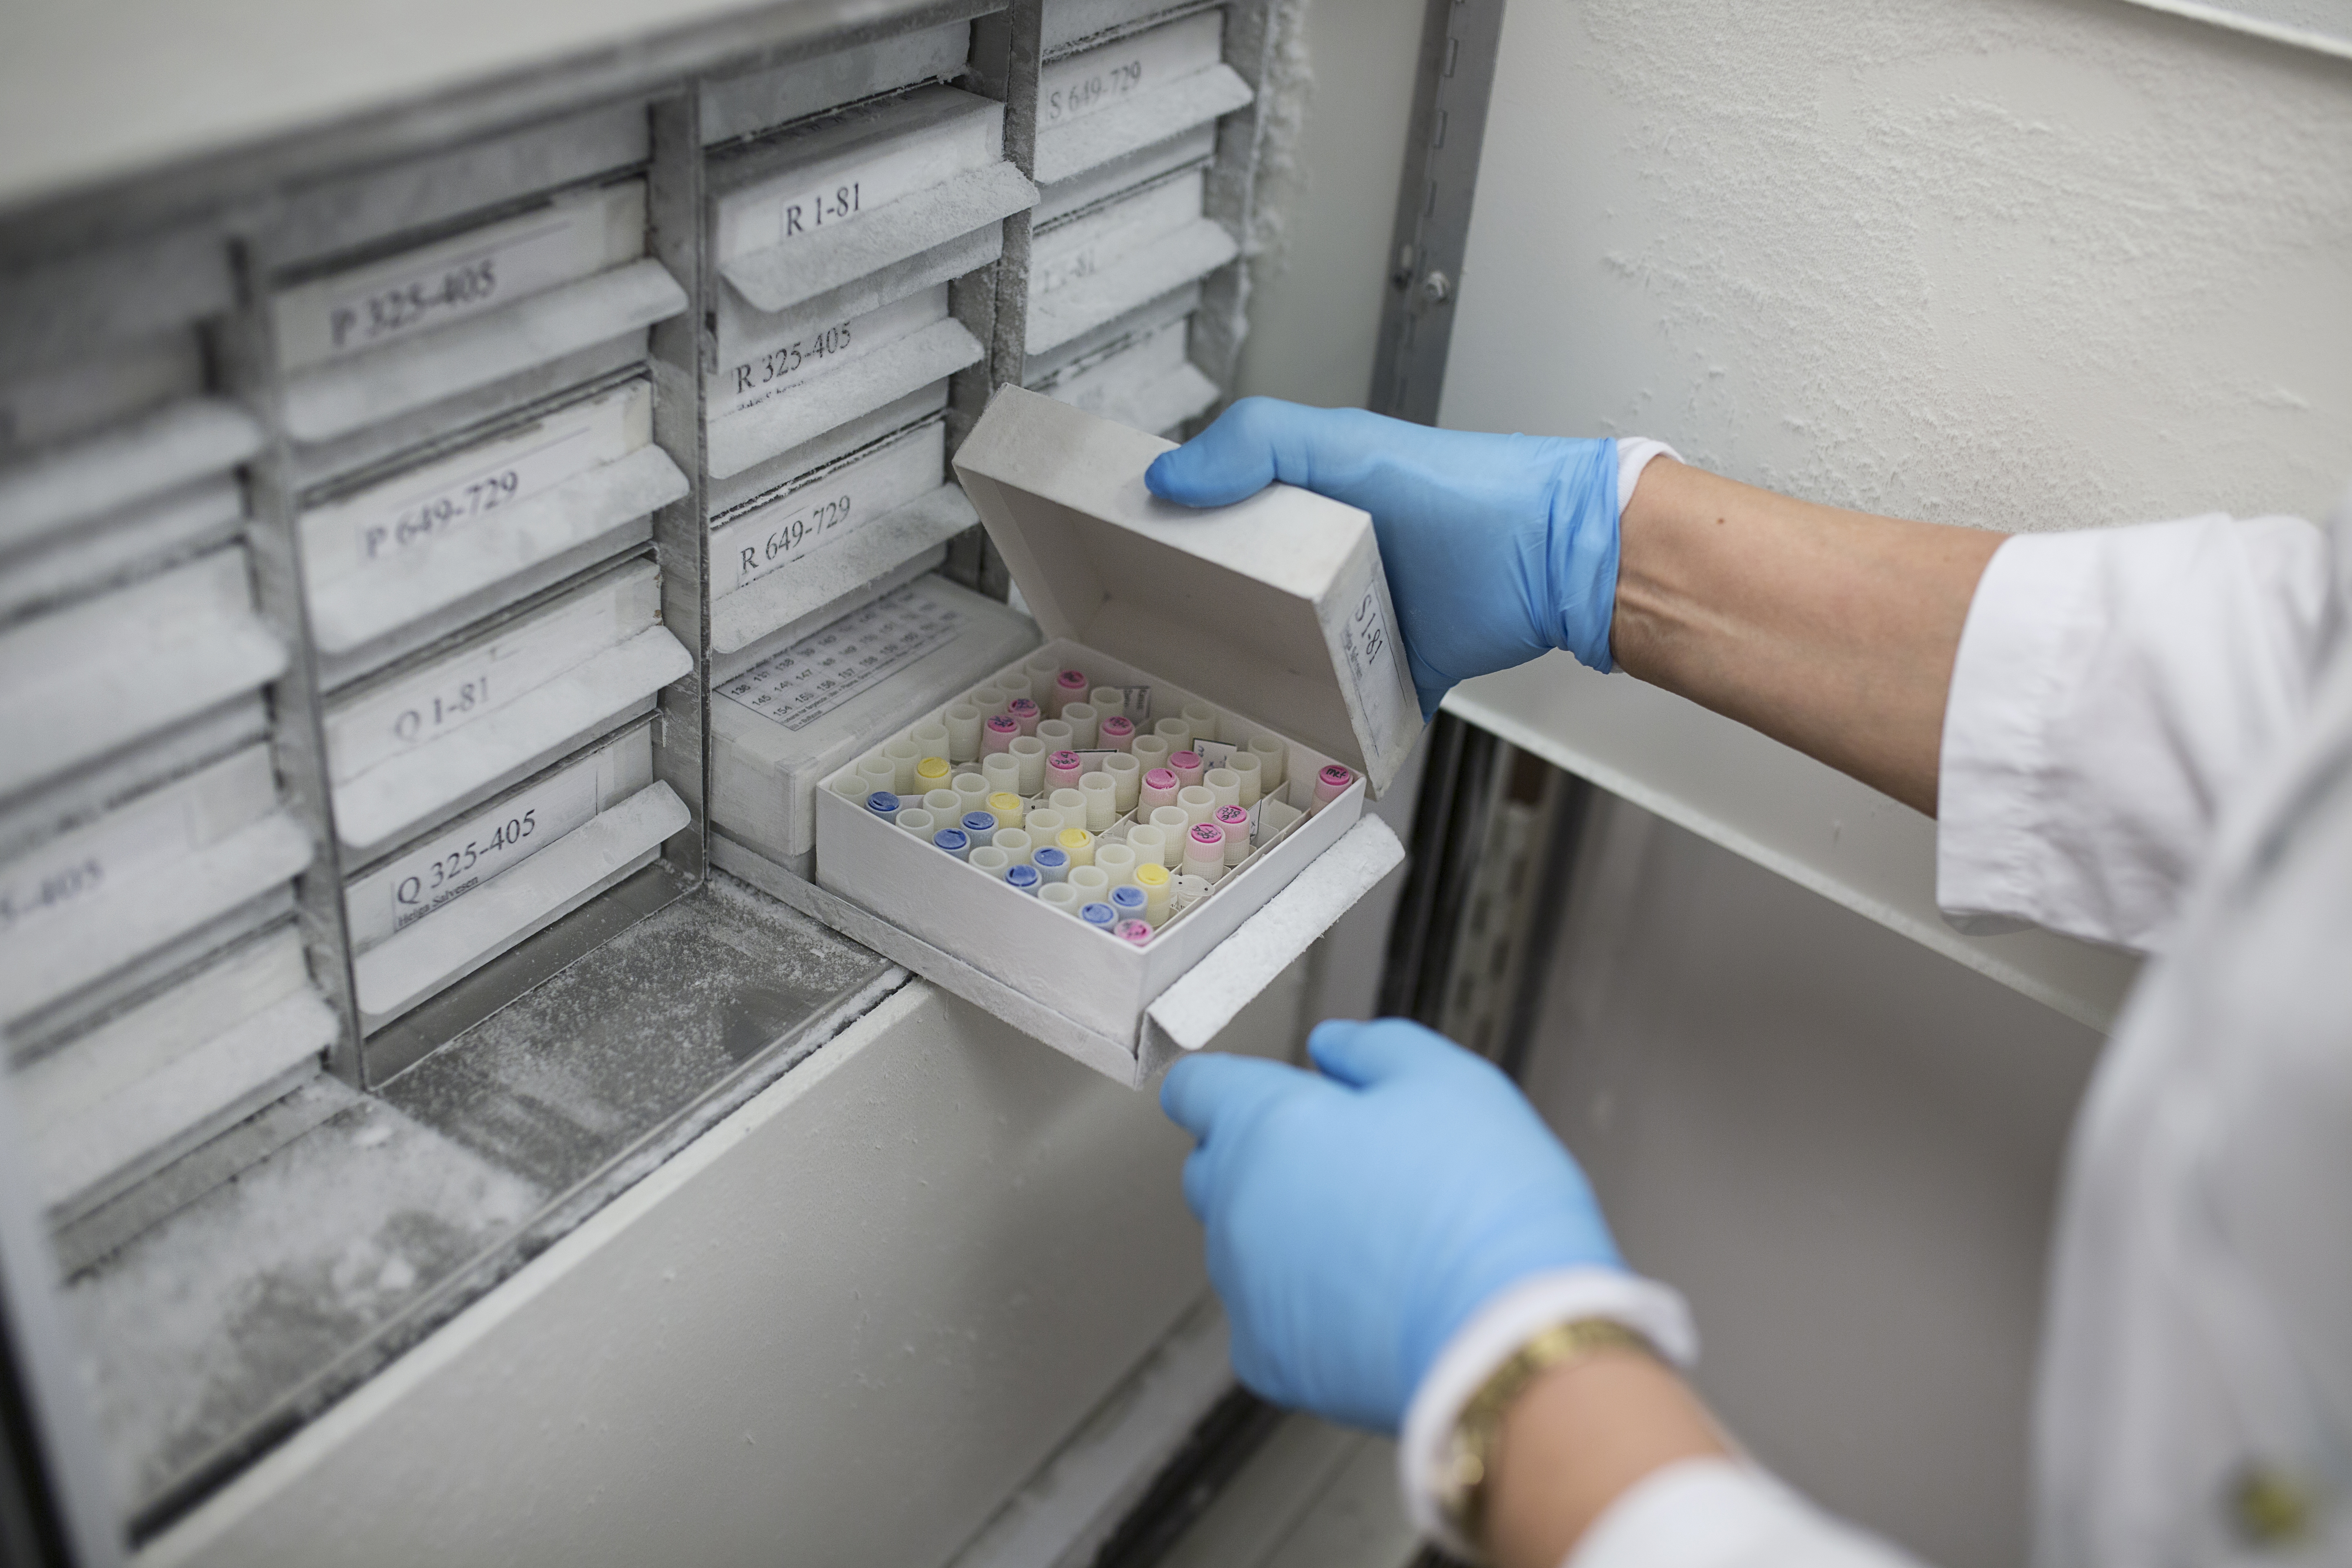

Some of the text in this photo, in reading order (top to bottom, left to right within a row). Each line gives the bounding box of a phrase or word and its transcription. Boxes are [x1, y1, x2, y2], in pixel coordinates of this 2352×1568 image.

[1050, 60, 1142, 120] S 649-729
[785, 182, 861, 237] R 1-81
[331, 307, 354, 345] P
[735, 321, 852, 394] R 325-405
[365, 470, 519, 559] P 649-729
[740, 495, 851, 575] R 649-729
[1355, 594, 1383, 665] S 1-81
[432, 676, 490, 724] 1-81
[397, 808, 535, 904] Q 325-405
